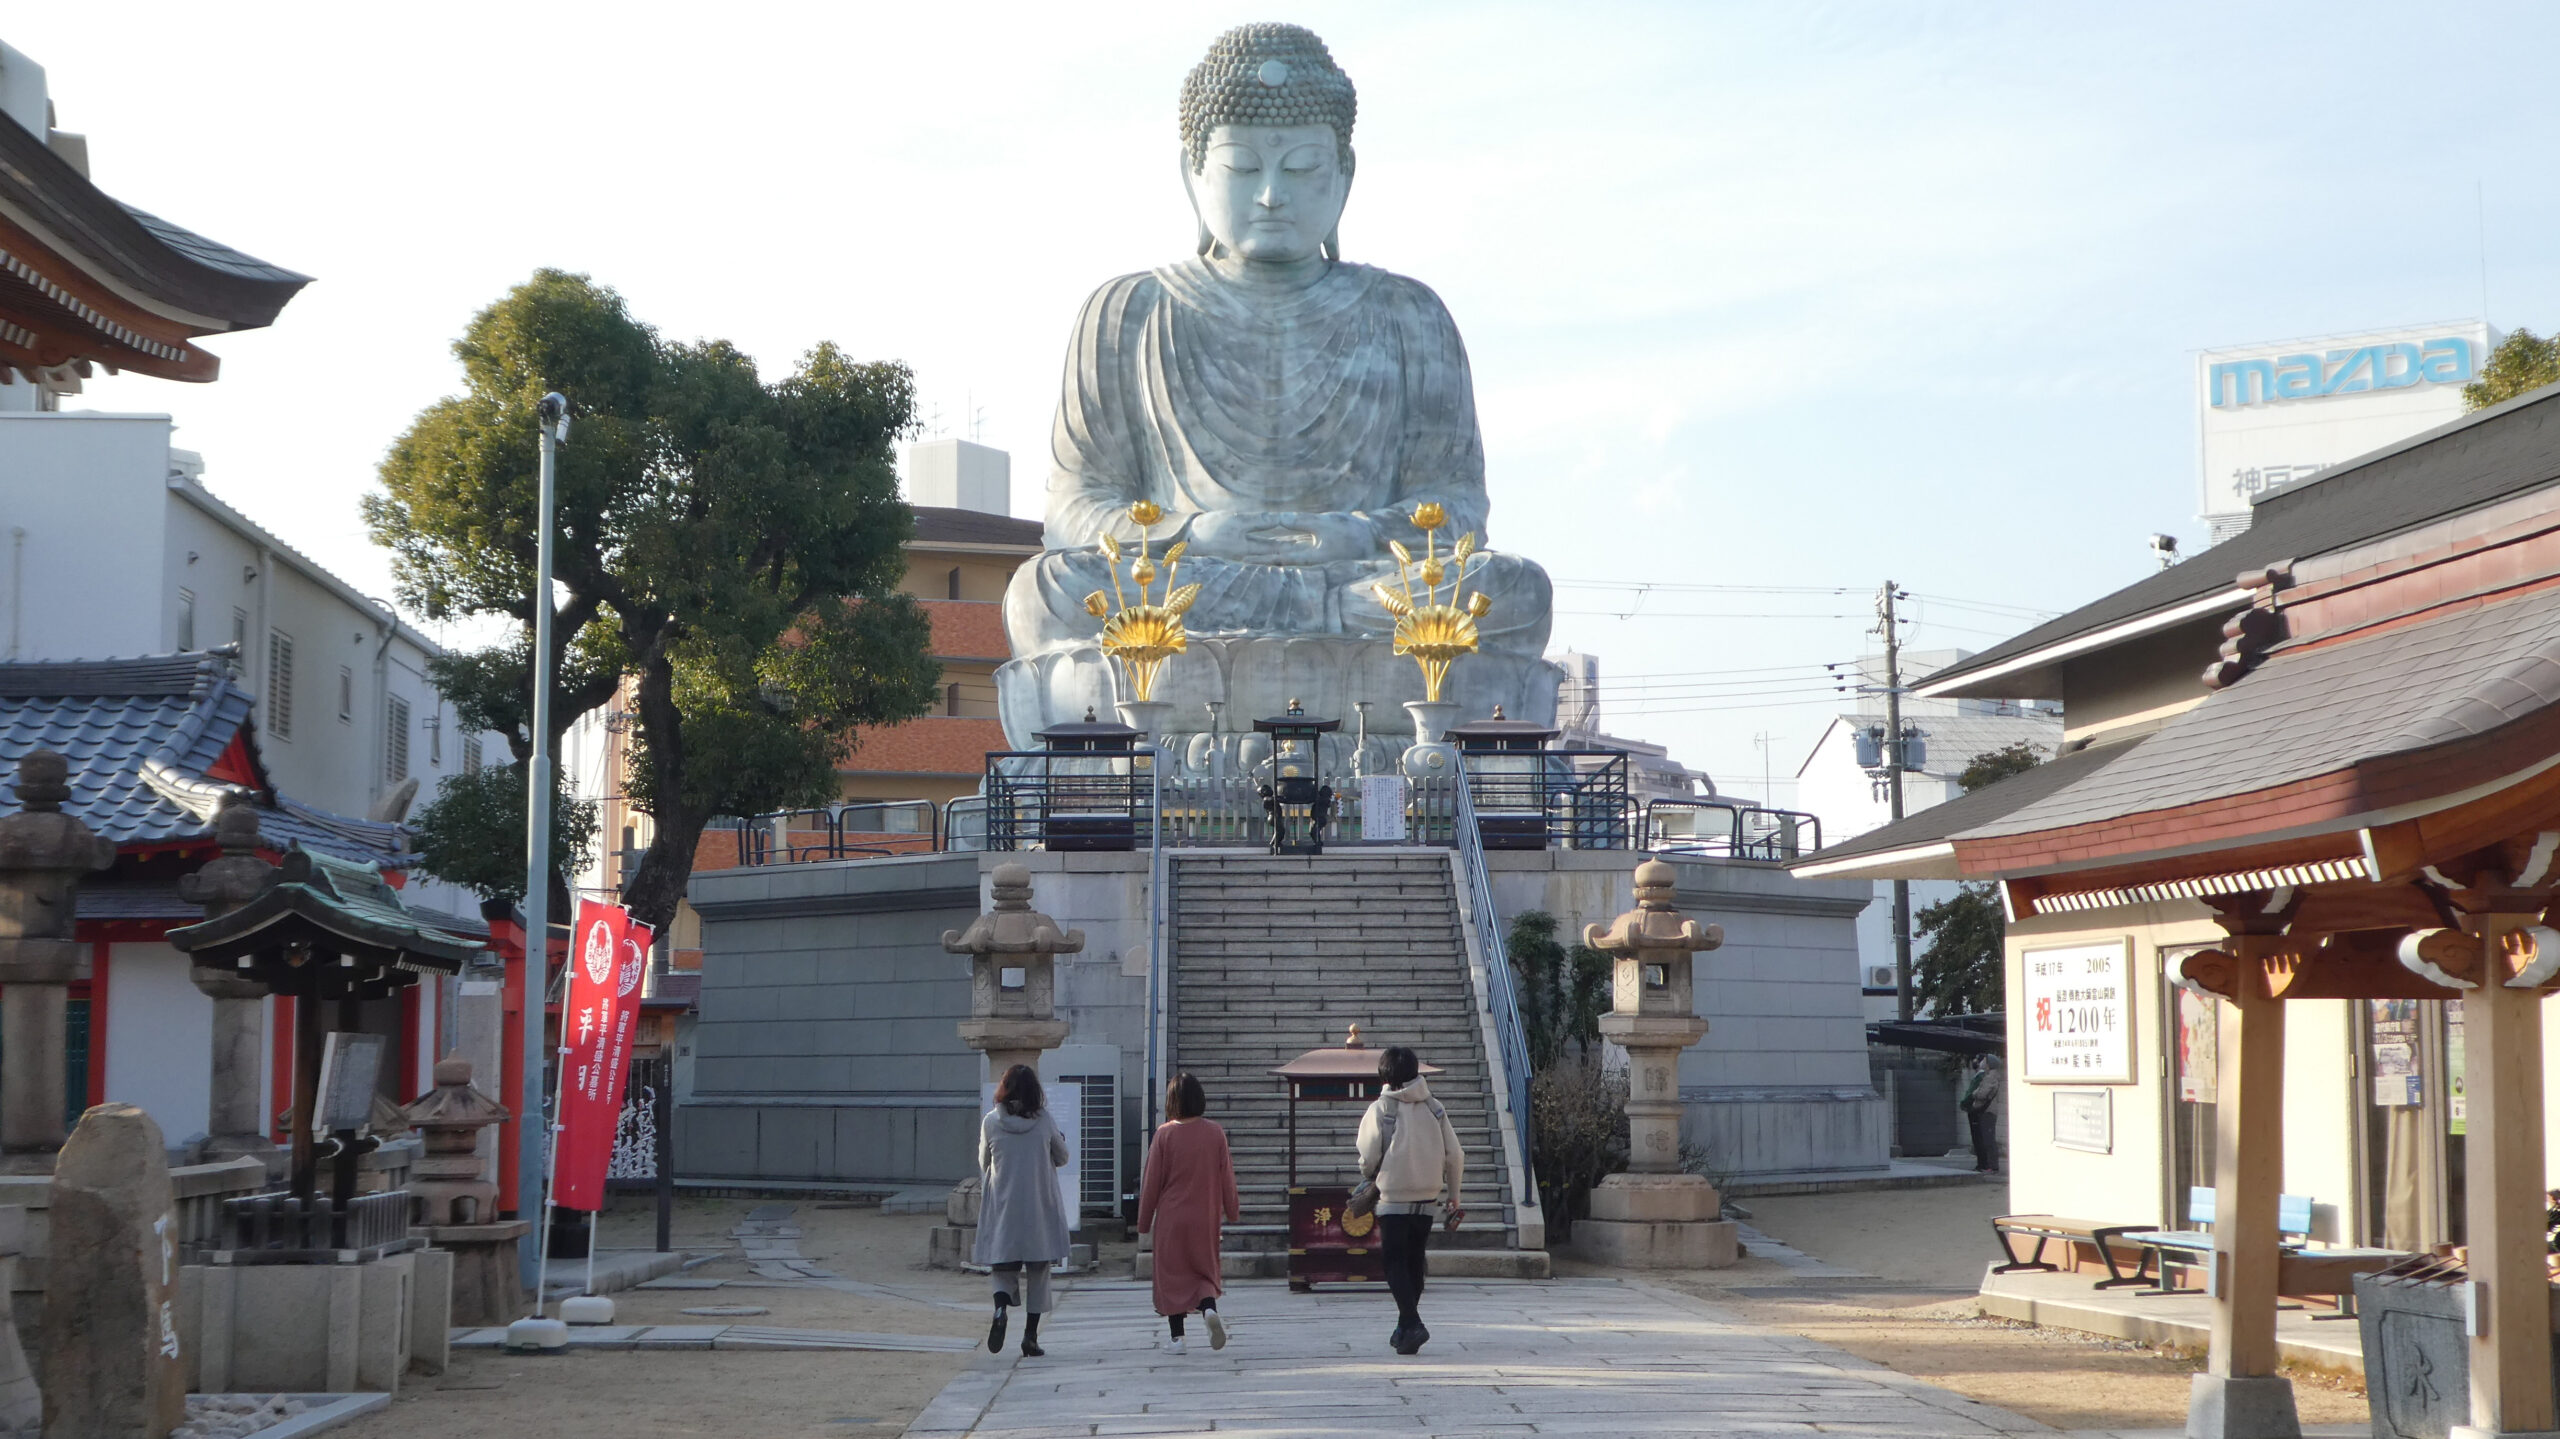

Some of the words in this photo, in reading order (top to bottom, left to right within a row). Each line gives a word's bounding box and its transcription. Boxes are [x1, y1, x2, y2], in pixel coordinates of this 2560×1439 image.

[2233, 463, 2337, 497] 神戸
[2086, 957, 2111, 973] 2005
[2036, 997, 2052, 1031] 祝
